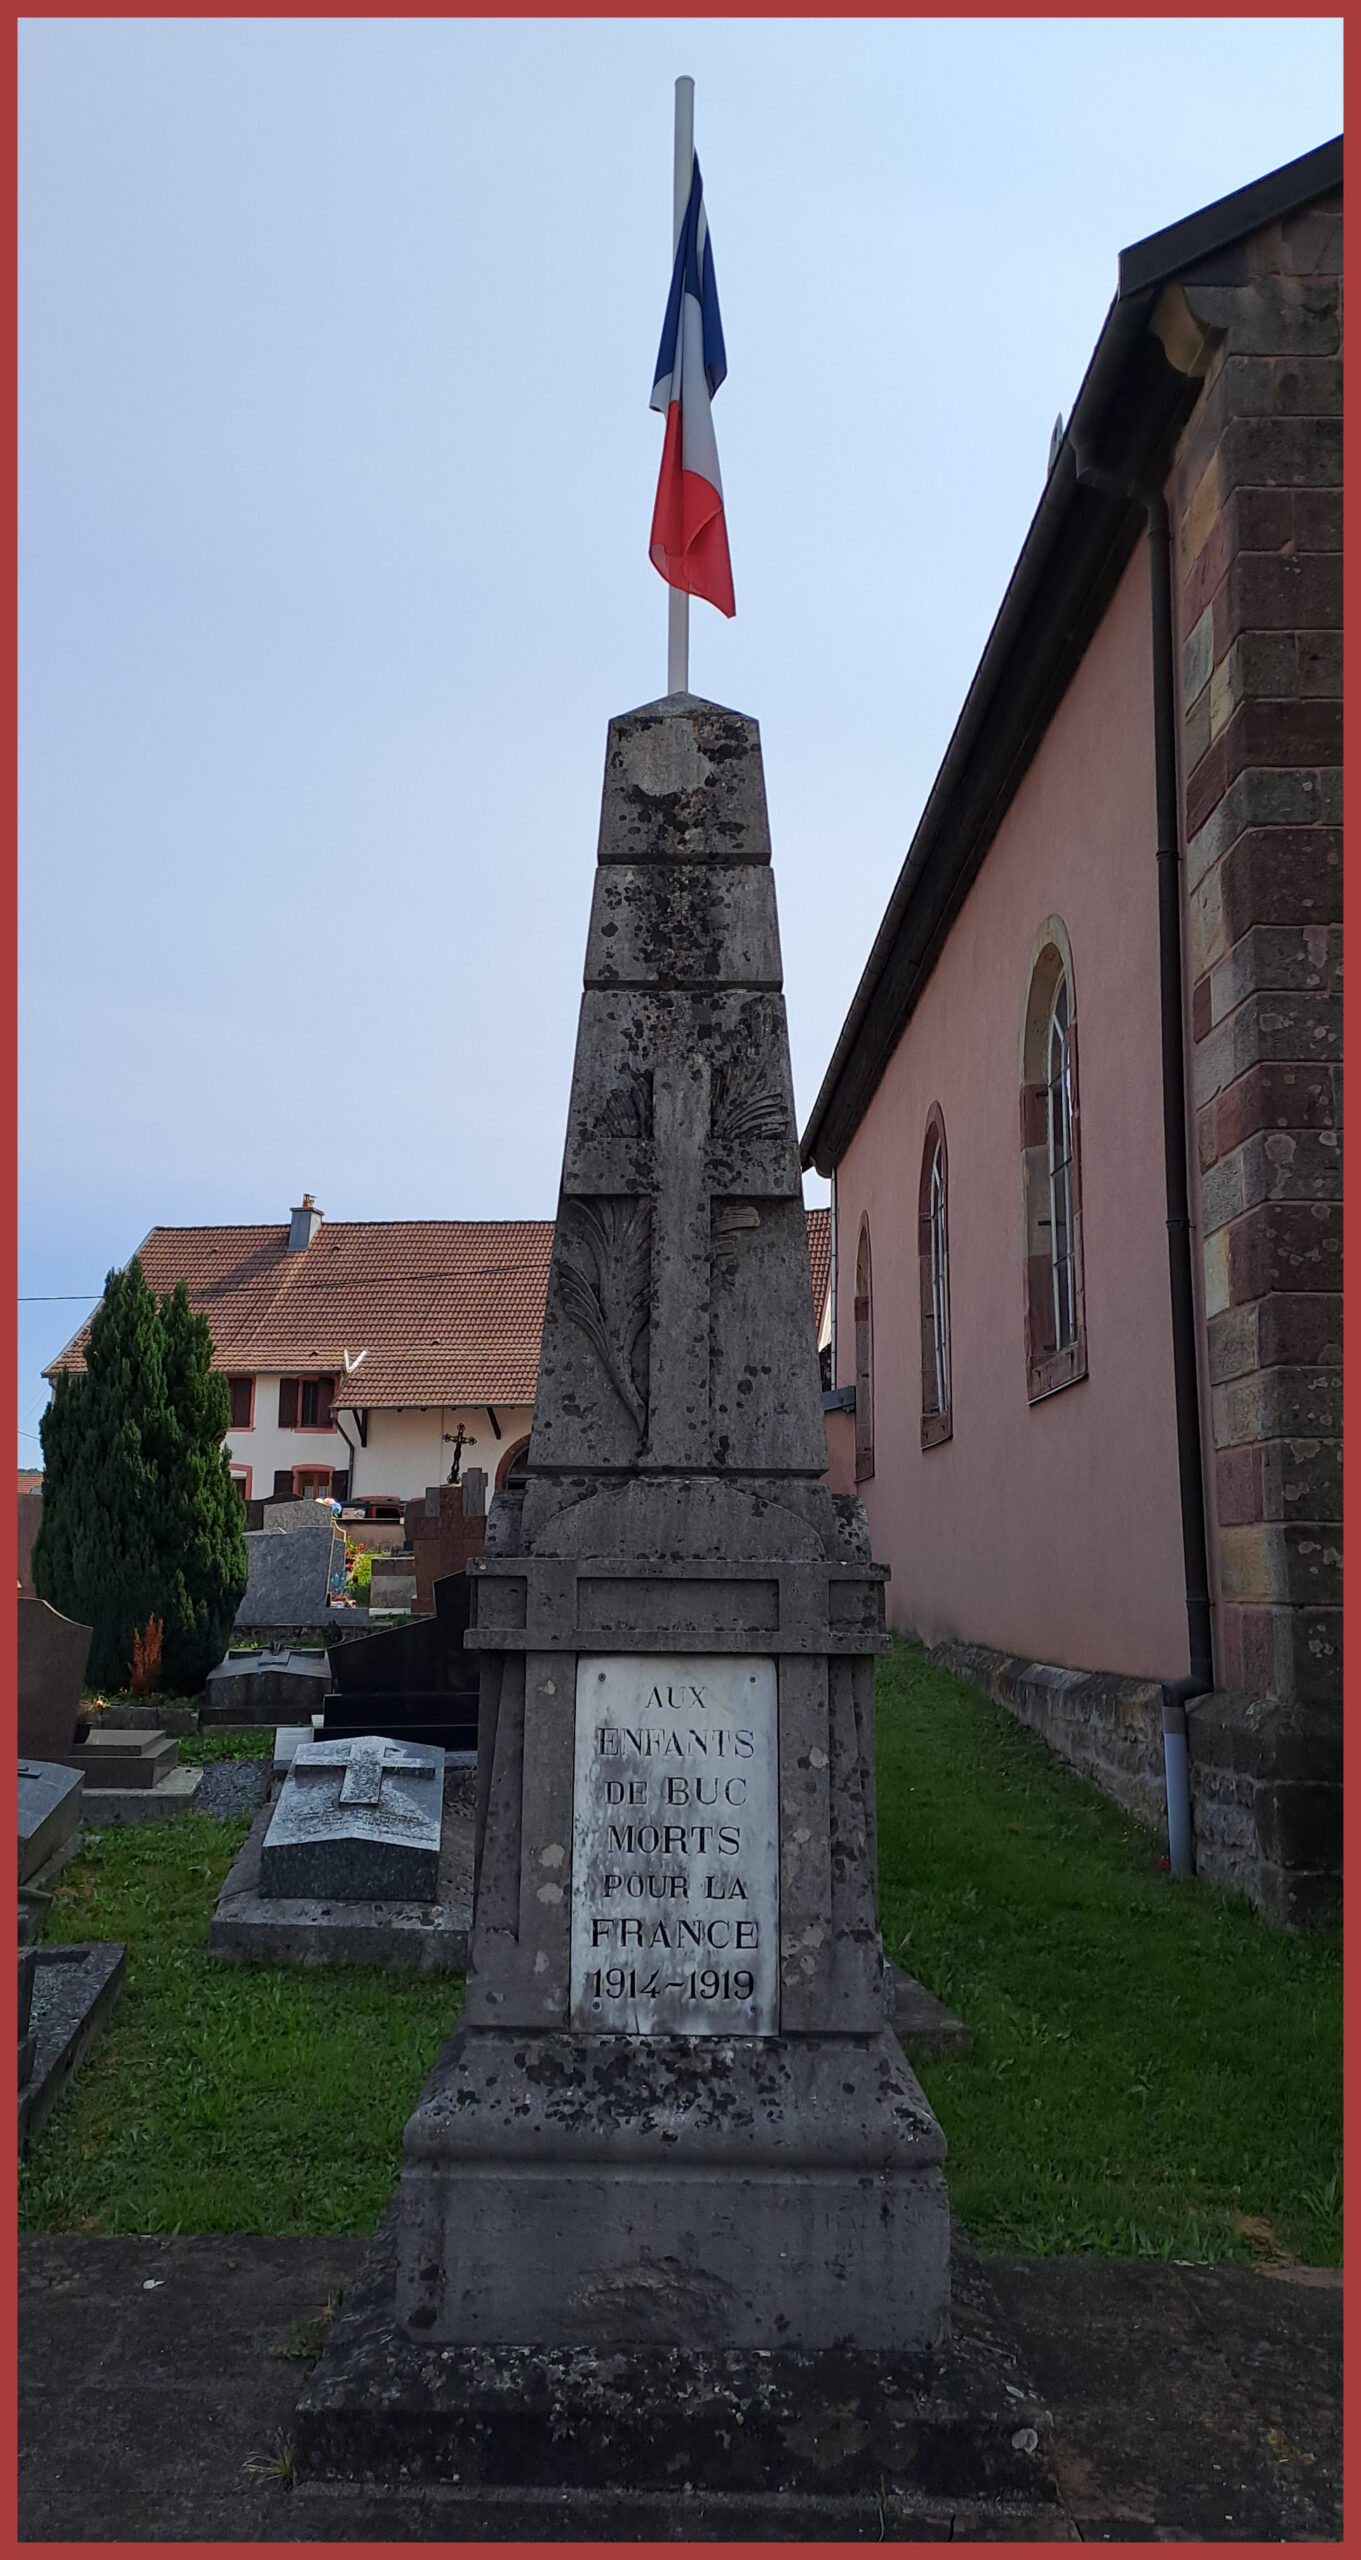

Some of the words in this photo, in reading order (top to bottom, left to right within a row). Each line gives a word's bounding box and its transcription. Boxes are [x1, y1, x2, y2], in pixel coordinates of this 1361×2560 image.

[645, 1686, 708, 1708] AUX
[598, 1727, 755, 1759] ENFANTS
[606, 1780, 648, 1806] DE
[666, 1777, 748, 1806] BUC
[608, 1825, 741, 1856] MORTS
[602, 1875, 690, 1899] POUR
[705, 1876, 749, 1900] LA
[590, 1918, 759, 1949] FRANCE
